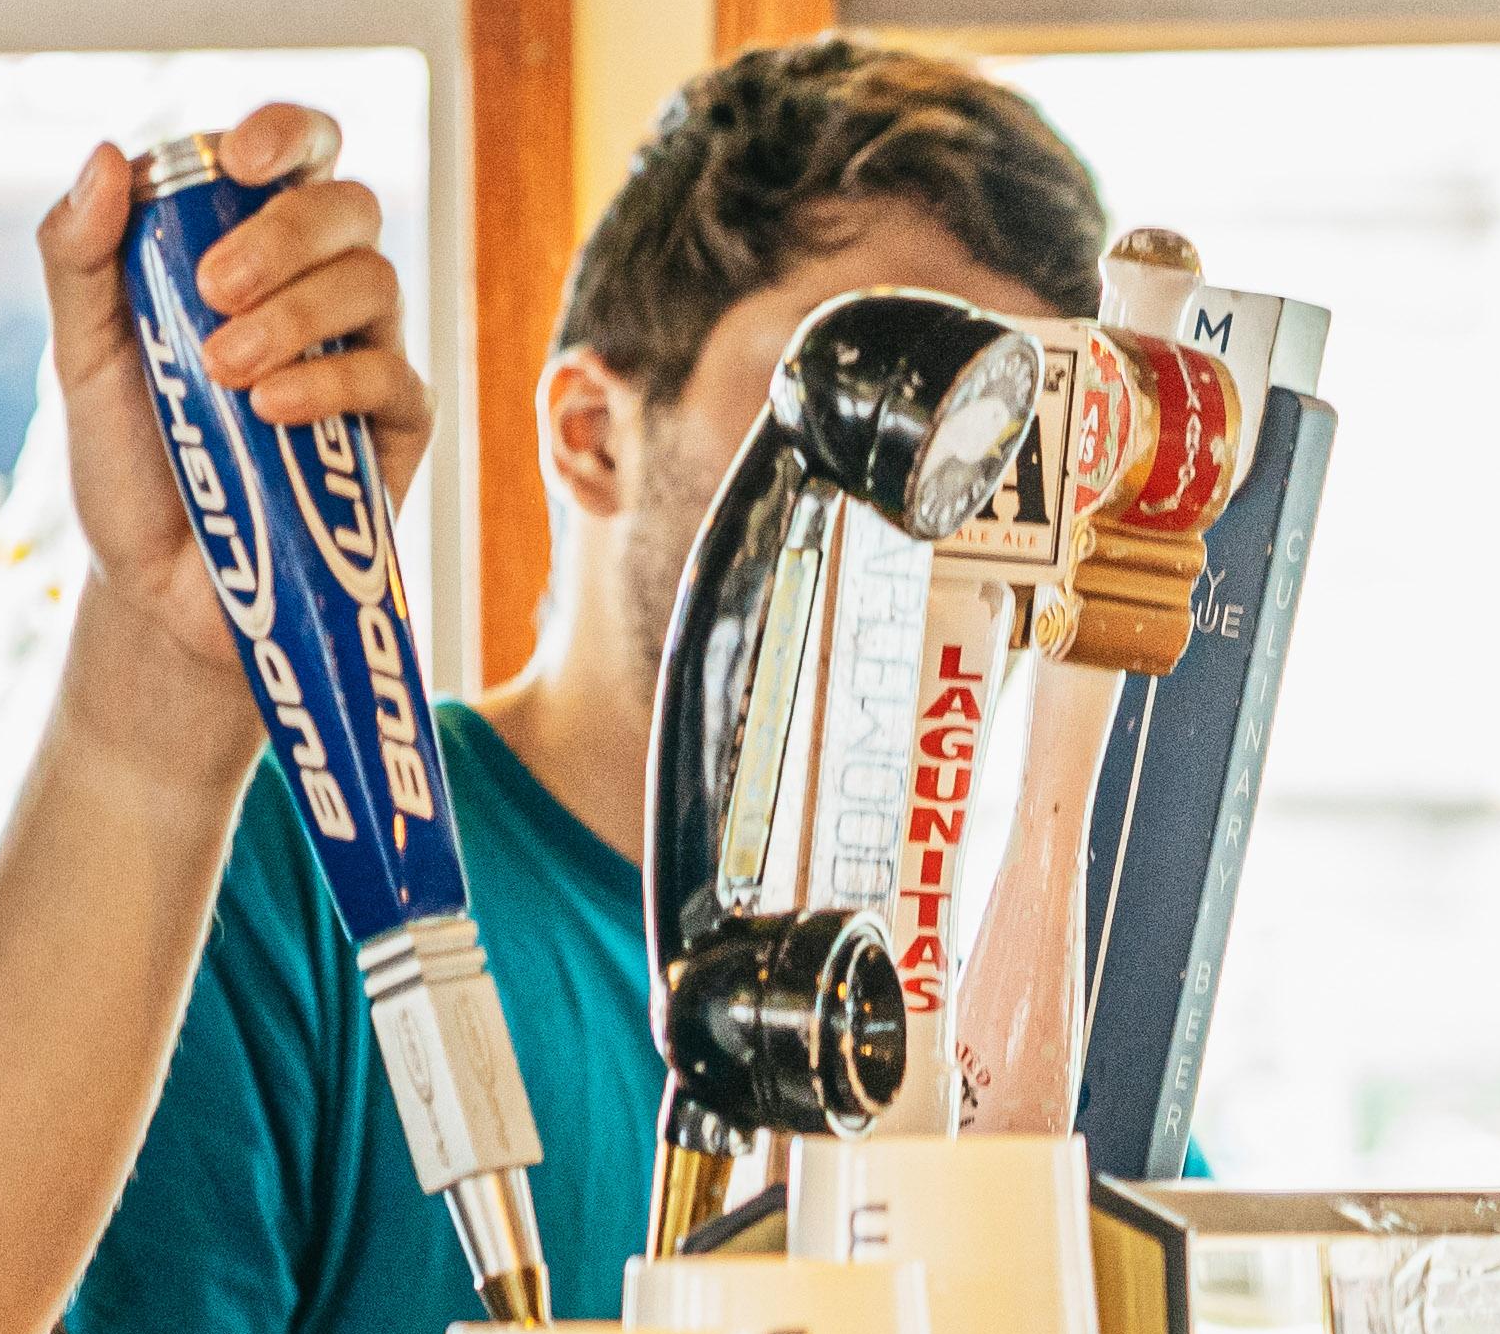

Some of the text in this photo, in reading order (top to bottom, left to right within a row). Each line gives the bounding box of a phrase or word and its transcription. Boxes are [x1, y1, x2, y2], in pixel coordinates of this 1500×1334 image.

[138, 314, 358, 843] BUD LIGHT
[313, 413, 435, 822] BUD LIG
[1215, 528, 1305, 897] CULINARY
[896, 643, 984, 1015] LAGUNITAS
[1163, 959, 1213, 1138] BEER
